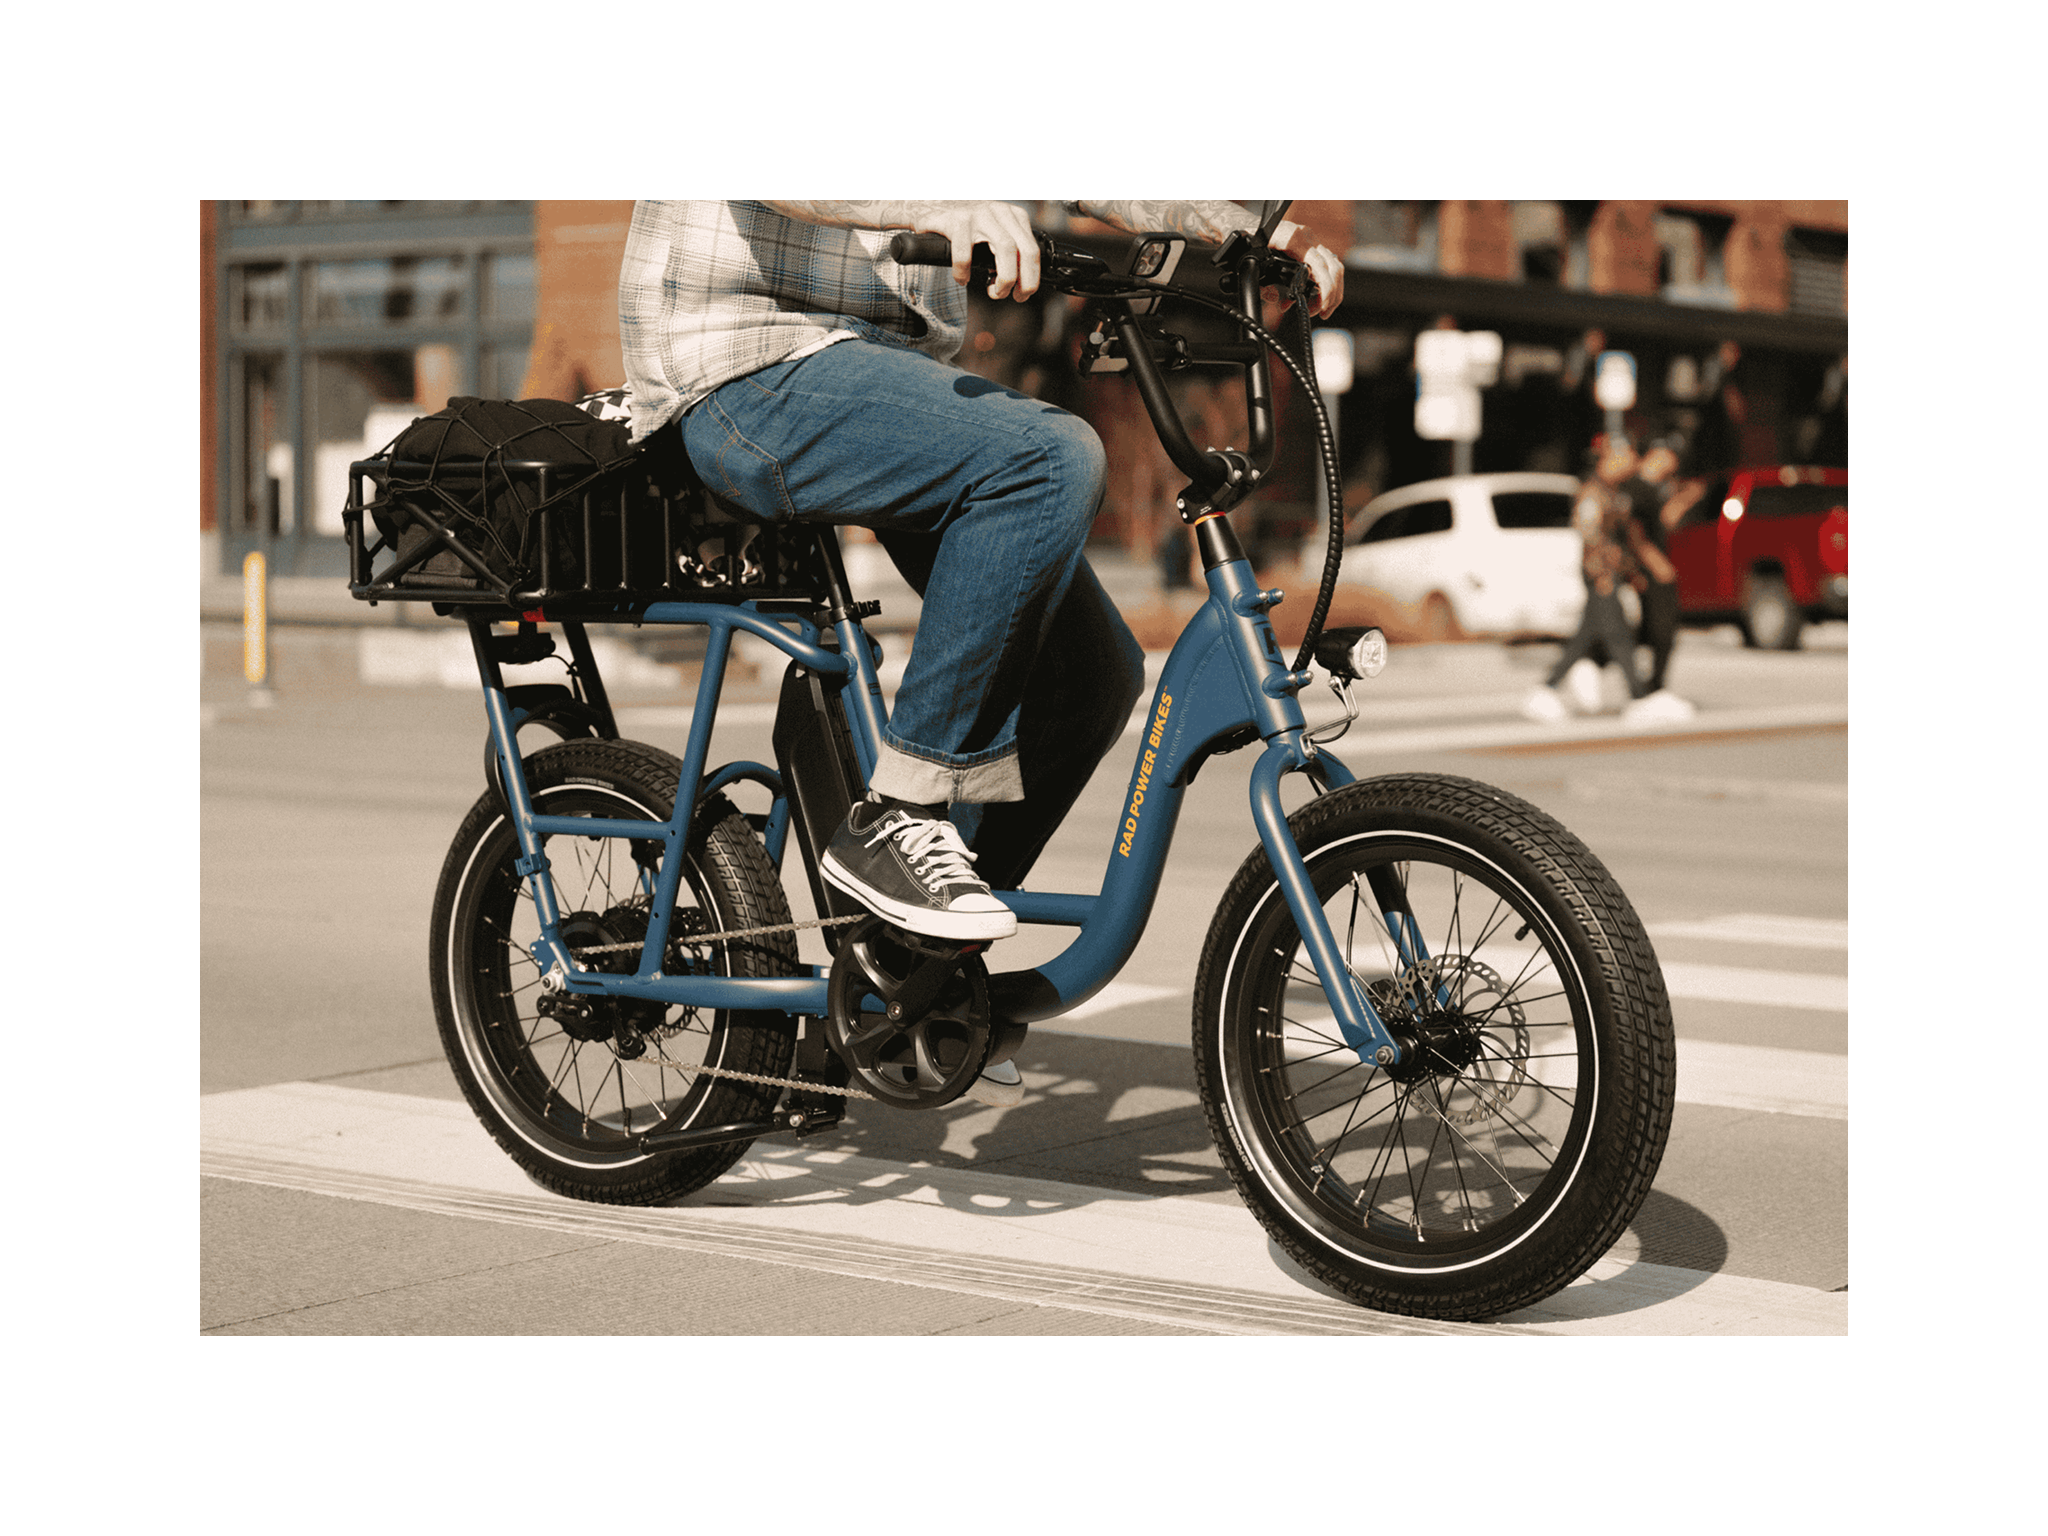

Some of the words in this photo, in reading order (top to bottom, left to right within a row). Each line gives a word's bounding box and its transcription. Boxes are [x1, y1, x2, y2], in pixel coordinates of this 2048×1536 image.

[1119, 817, 1137, 858] RAD
[1129, 749, 1157, 818] POWER
[1148, 692, 1173, 749] BIKES
